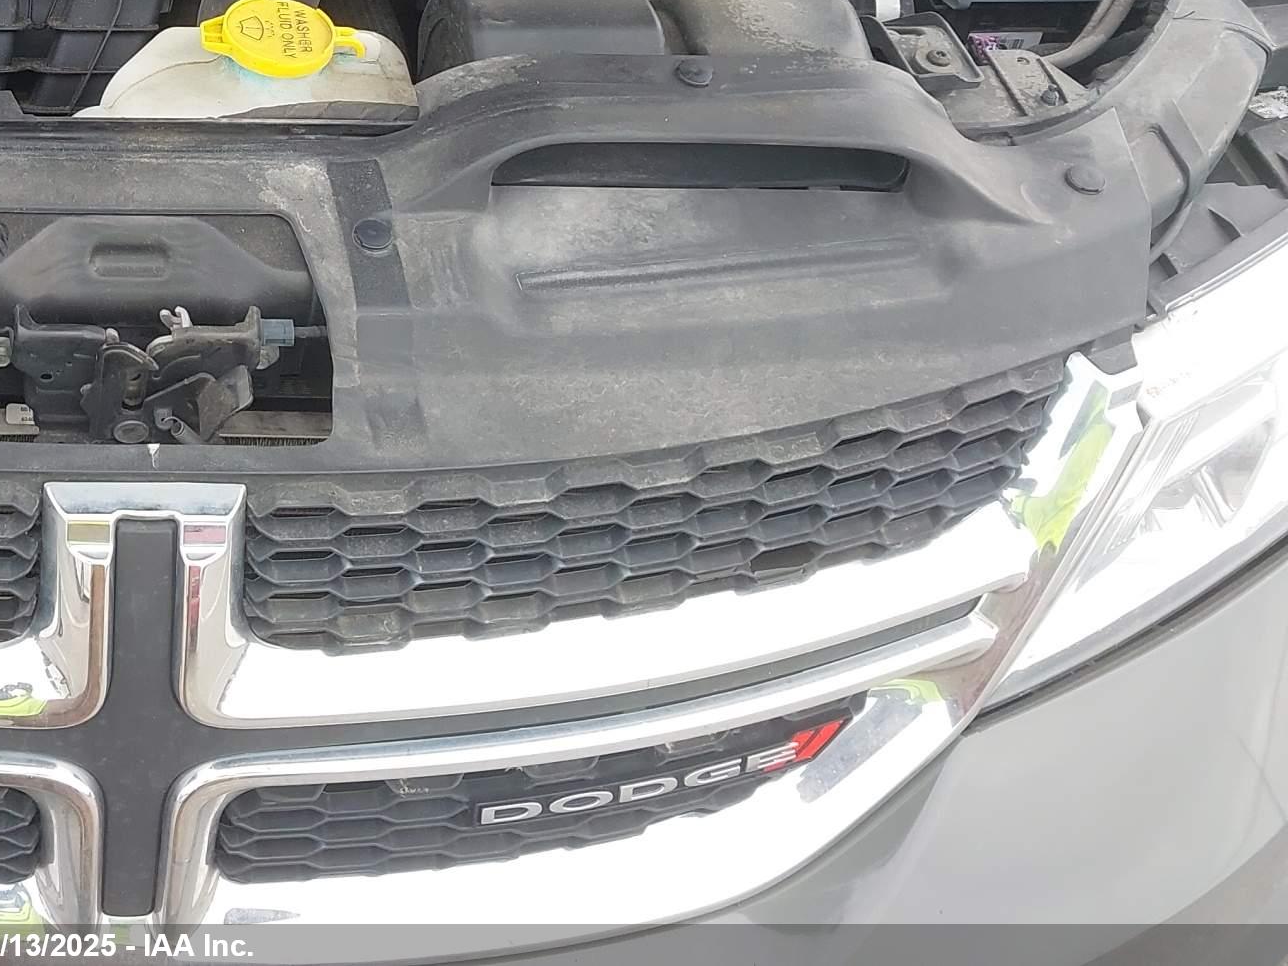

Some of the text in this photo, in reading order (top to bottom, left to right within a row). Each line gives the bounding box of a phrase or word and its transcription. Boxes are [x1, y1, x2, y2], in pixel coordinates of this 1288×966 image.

[277, 2, 298, 59] FLUID ONLY
[294, 10, 312, 52] WASHER
[481, 741, 799, 824] DODGE
